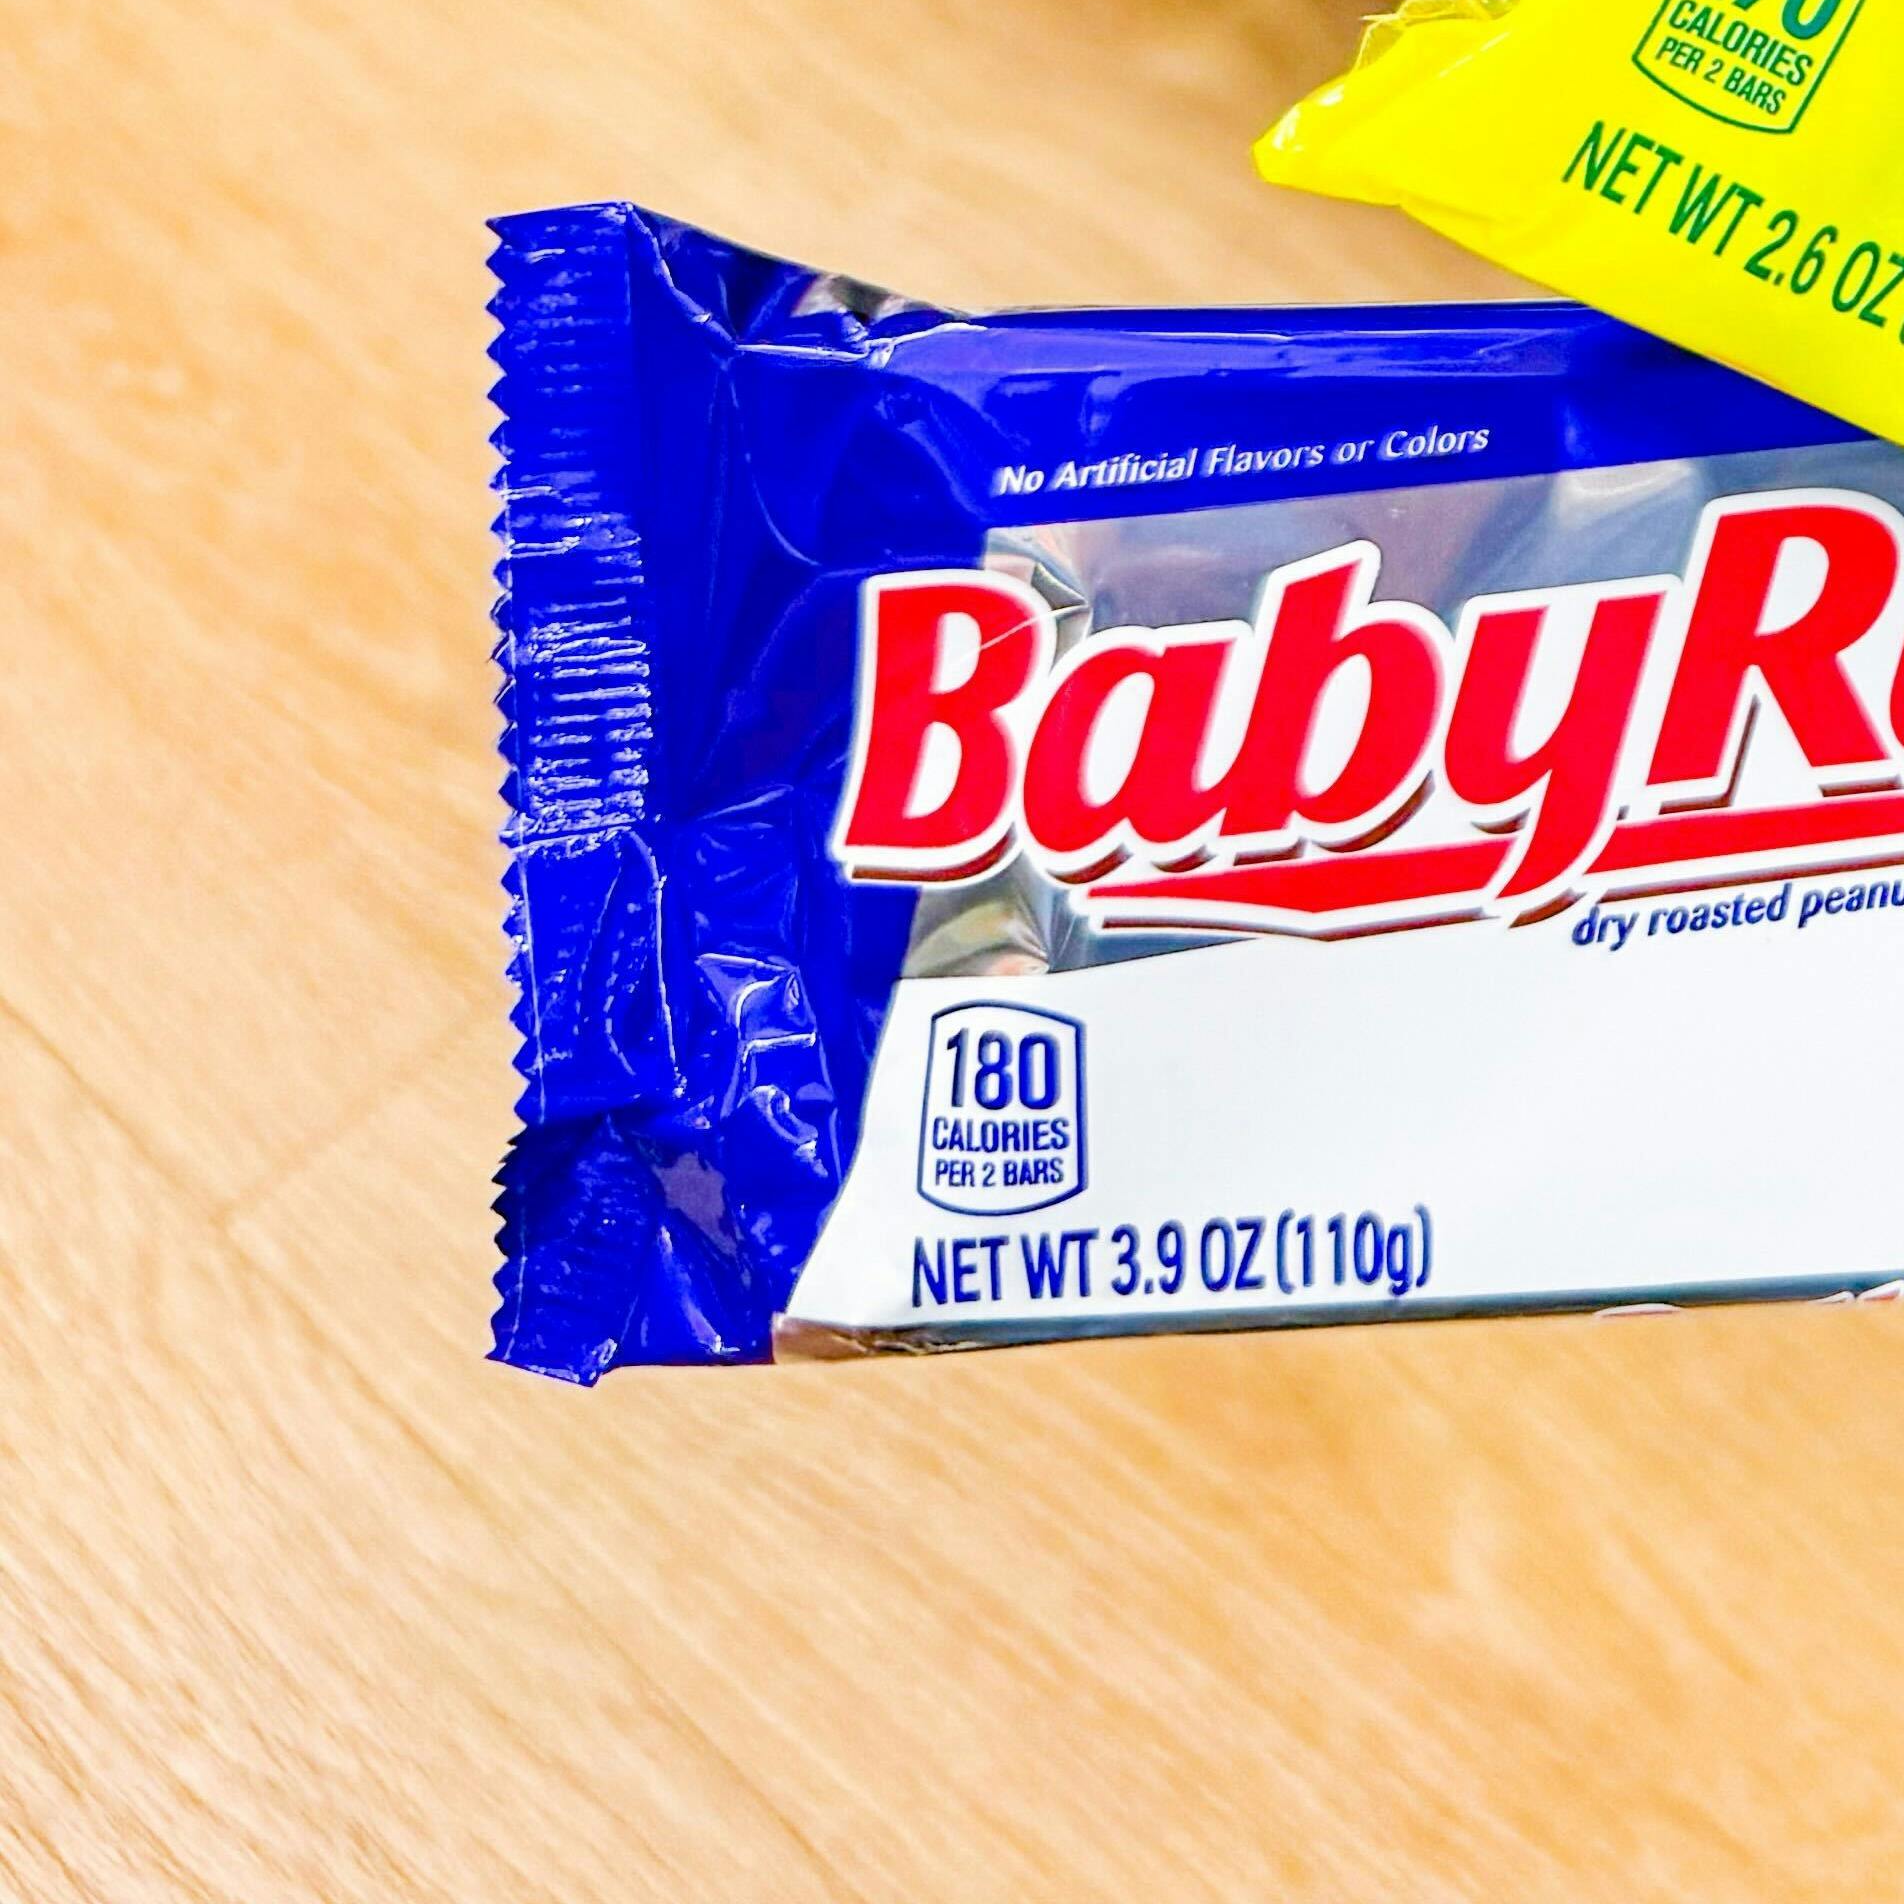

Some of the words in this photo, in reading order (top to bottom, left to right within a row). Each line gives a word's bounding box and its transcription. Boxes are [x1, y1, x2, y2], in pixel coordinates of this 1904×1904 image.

[1656, 37, 1706, 76] PER
[1707, 60, 1722, 83] 2
[1724, 65, 1787, 118] BARS
[1669, 0, 1812, 86] CALORIES
[1562, 120, 1685, 205] NET
[1669, 168, 1766, 257] WT
[1744, 209, 1838, 295] 2.6
[999, 466, 1045, 496] No
[1055, 448, 1198, 490] Artificial
[1208, 439, 1326, 476] Flavors
[1337, 439, 1375, 464] or
[1384, 424, 1492, 461] Colors
[1572, 903, 1639, 953] dry
[1647, 881, 1789, 937] roasted
[945, 1026, 1060, 1111] 180
[931, 1116, 1070, 1155] CALORIES
[934, 1159, 976, 1188] PER
[982, 1161, 996, 1188] 2
[1003, 1157, 1064, 1187] BARS
[912, 1235, 1010, 1308] NET
[1021, 1226, 1103, 1302] WT
[1111, 1223, 1185, 1295] 3.9
[1201, 1215, 1265, 1292] OZ
[1276, 1204, 1434, 1296] (110g)
